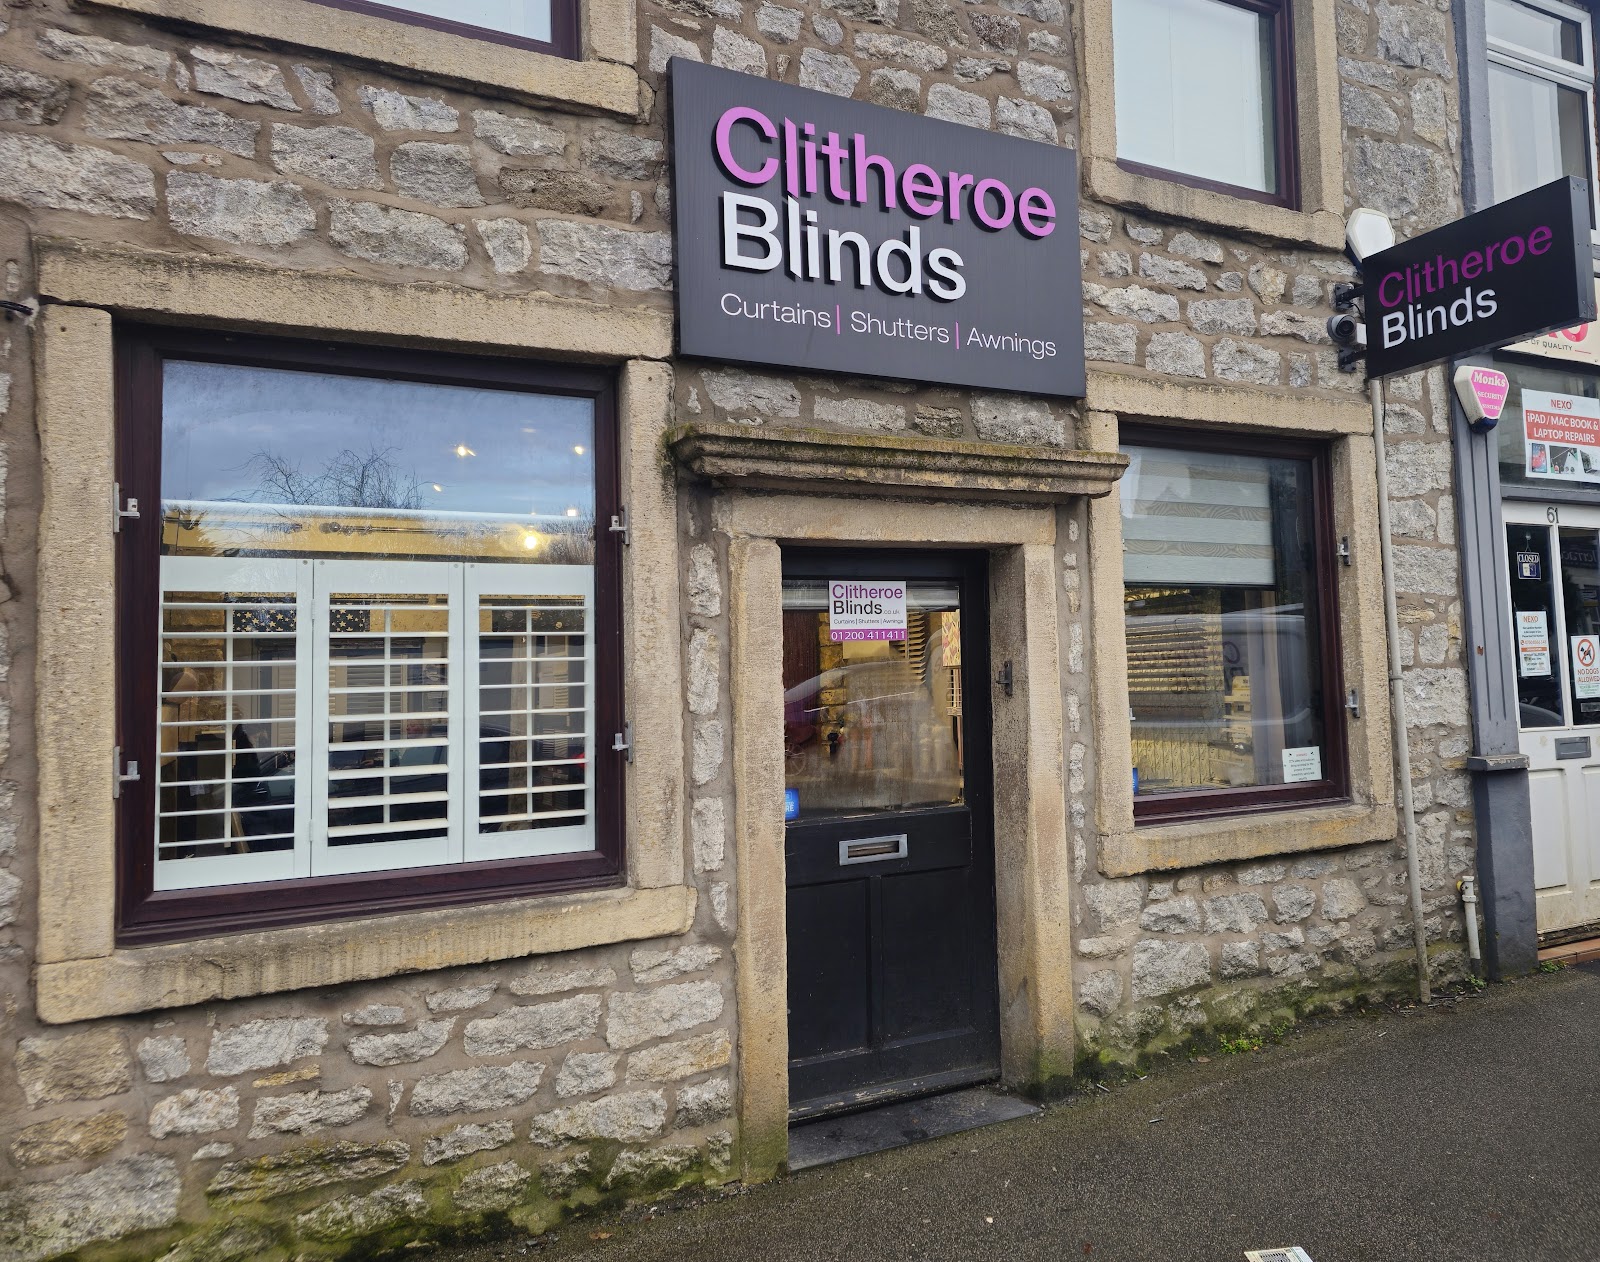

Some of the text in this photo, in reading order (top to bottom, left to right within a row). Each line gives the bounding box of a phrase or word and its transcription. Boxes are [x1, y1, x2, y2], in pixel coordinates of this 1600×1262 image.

[715, 106, 1056, 237] Clitheroe
[722, 190, 967, 301] Blinds
[1378, 225, 1553, 308] Clitheroe
[1382, 286, 1498, 349] Blinds
[720, 292, 1057, 360] Curtains Shutters Awnings
[1542, 340, 1573, 351] QUALITY
[1473, 371, 1506, 388] Monks
[1477, 391, 1504, 401] SECURITY
[1550, 399, 1572, 410] NEXO
[1527, 412, 1546, 424] iPAD
[1551, 416, 1569, 427] MAC
[1570, 419, 1592, 431] BOOK
[1593, 421, 1599, 431] &
[1533, 427, 1596, 443] LAPTOP REPAIRS
[1546, 506, 1559, 524] 61
[1518, 554, 1540, 563] CLOSED
[832, 584, 903, 599] Clitheroe
[831, 630, 906, 640] 01200 411411
[1586, 667, 1600, 675] DOGS
